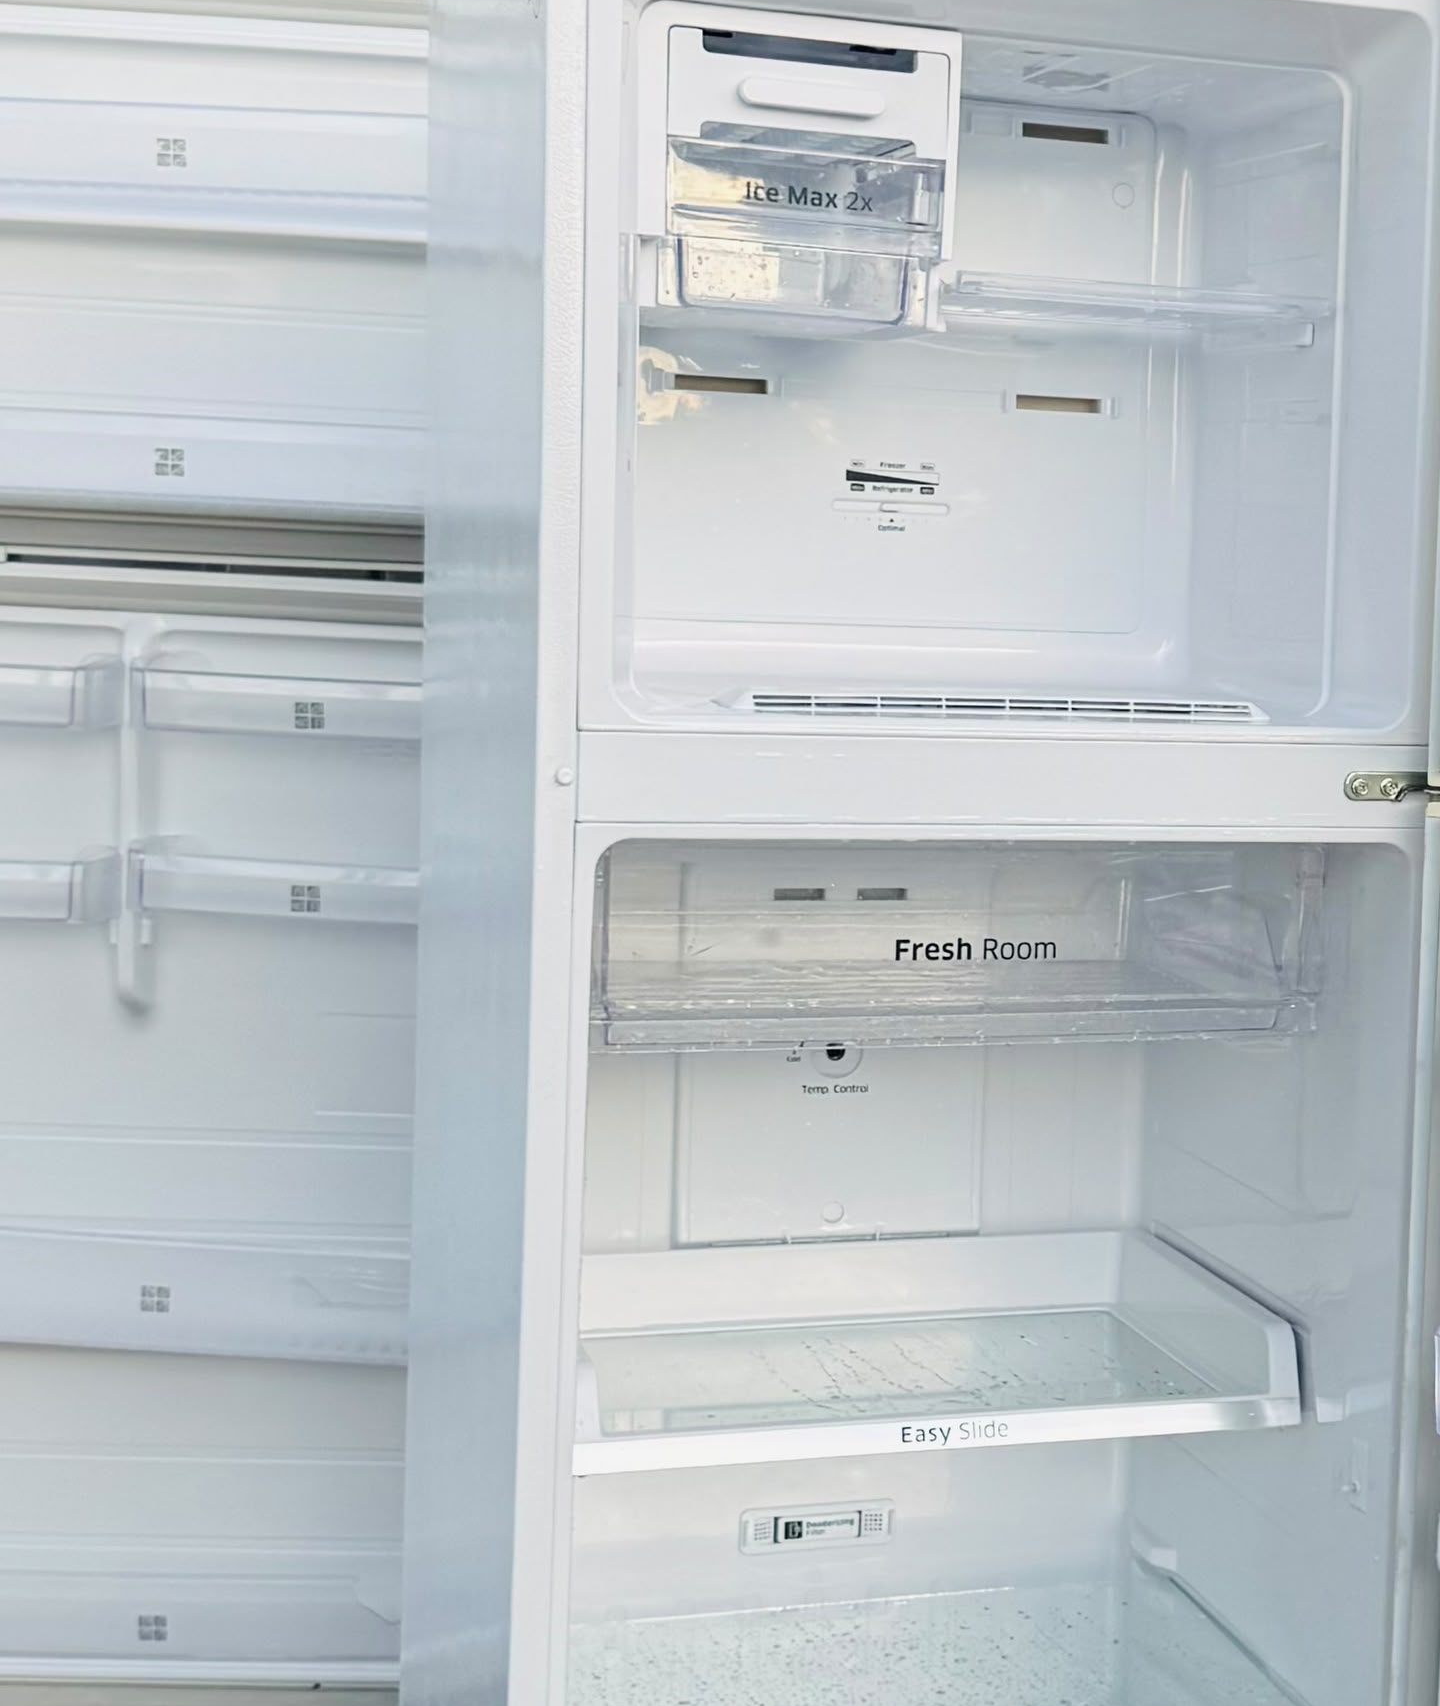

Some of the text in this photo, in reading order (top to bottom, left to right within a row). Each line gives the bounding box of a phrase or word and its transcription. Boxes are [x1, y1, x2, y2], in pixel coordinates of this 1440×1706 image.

[745, 181, 873, 212] Ice Max 2x
[895, 937, 1057, 961] Fresh Room
[833, 1084, 869, 1094] Control
[901, 1420, 1009, 1446] Easy Slide
